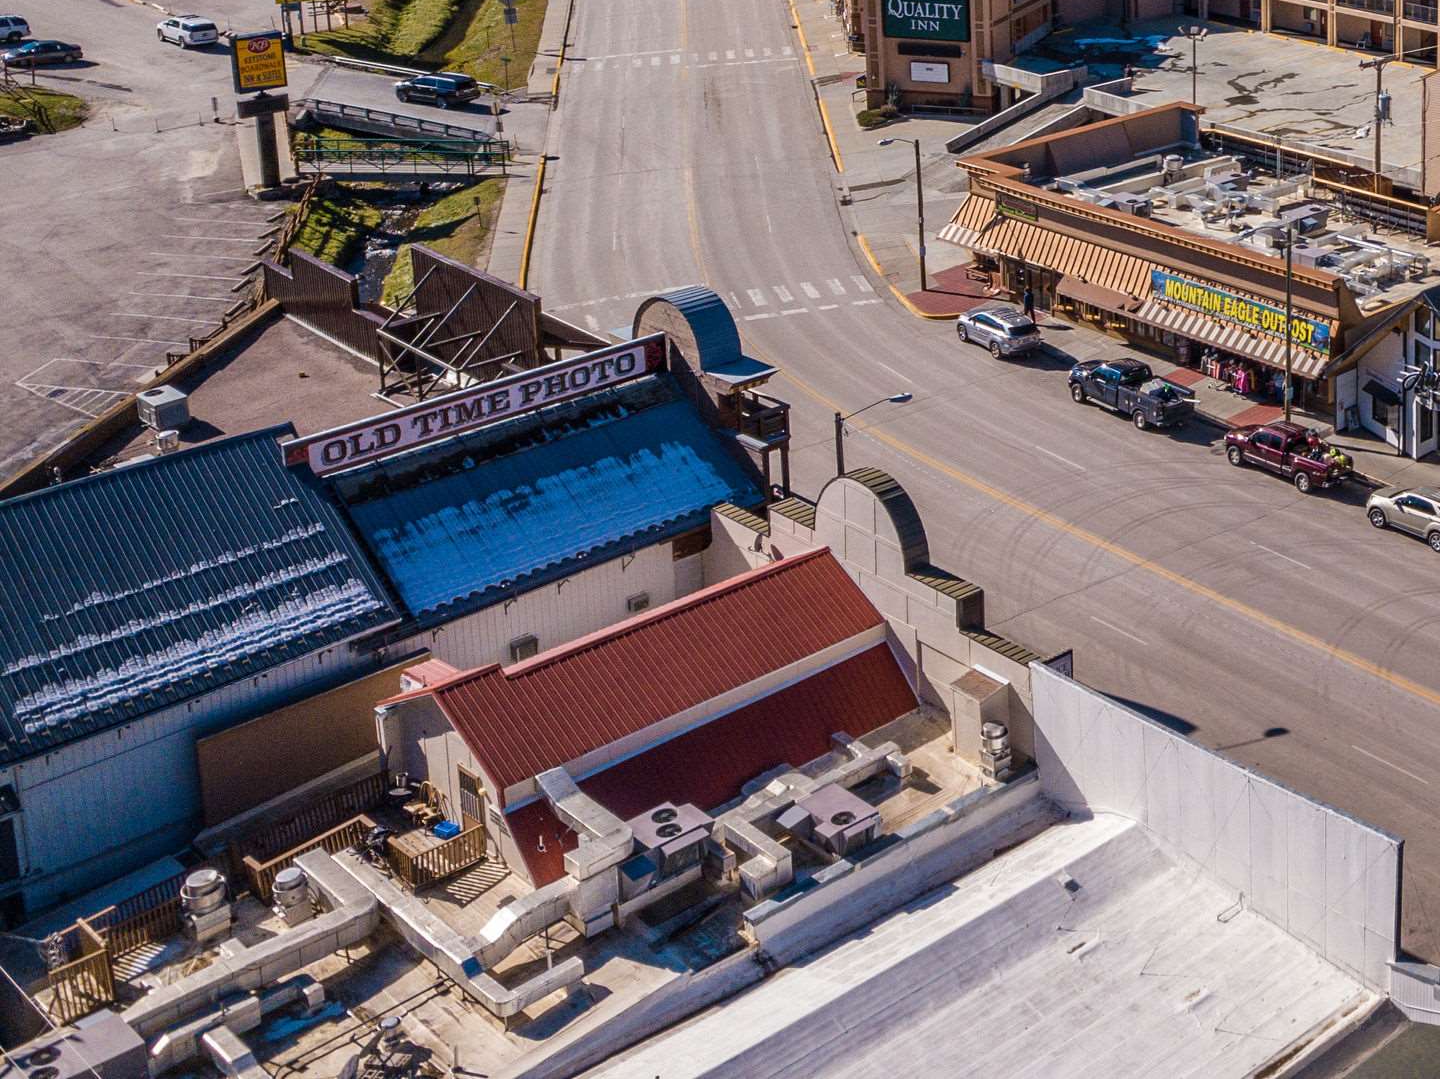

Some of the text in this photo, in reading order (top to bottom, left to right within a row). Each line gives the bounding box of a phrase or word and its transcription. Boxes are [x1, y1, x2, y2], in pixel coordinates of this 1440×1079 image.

[911, 20, 940, 32] INN
[1165, 279, 1222, 313] MOUNTAIN
[1224, 297, 1260, 325] EAGLE
[1262, 309, 1314, 344] OUTOST
[321, 352, 637, 467] OLD TIME PHOTO
